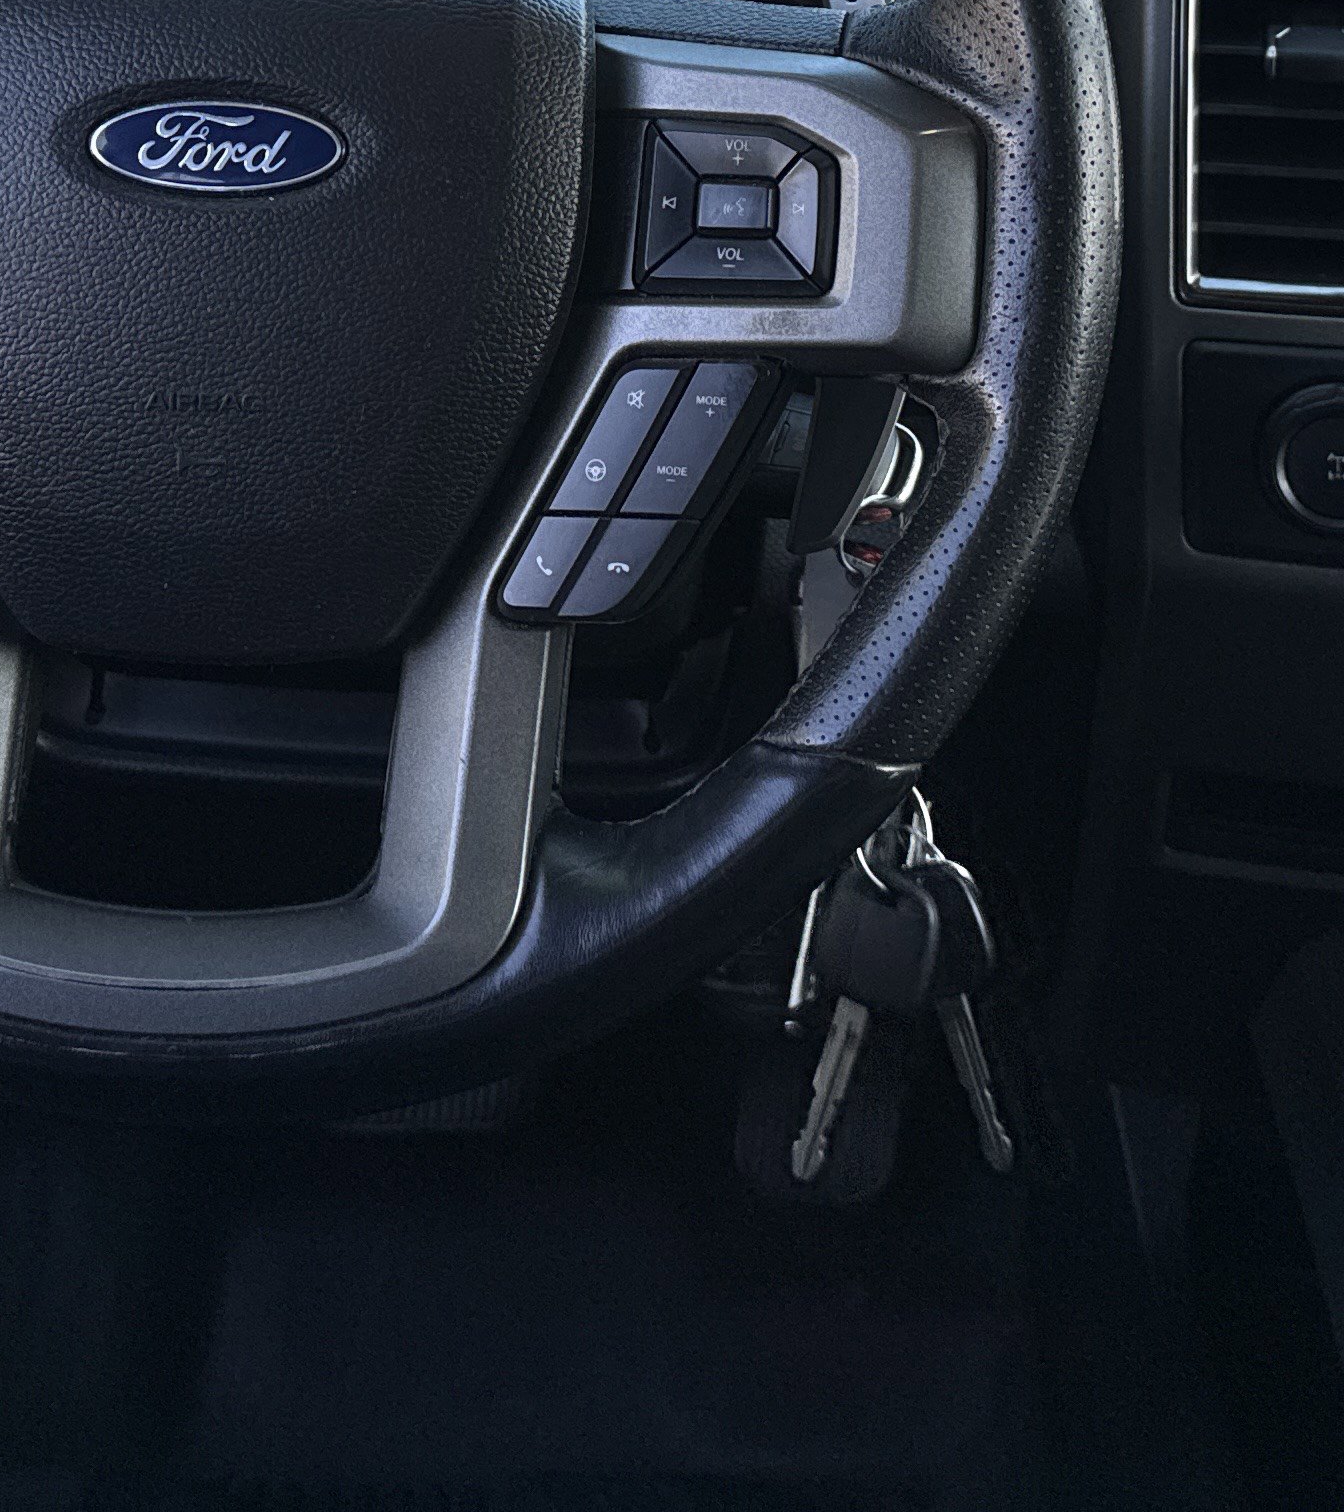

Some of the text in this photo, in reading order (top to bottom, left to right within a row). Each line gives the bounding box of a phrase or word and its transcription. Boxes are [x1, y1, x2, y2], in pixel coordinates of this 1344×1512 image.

[137, 109, 292, 174] Ford
[725, 138, 751, 152] VOL
[716, 247, 745, 262] VOL
[695, 394, 727, 407] MODE
[656, 465, 688, 477] MODE
